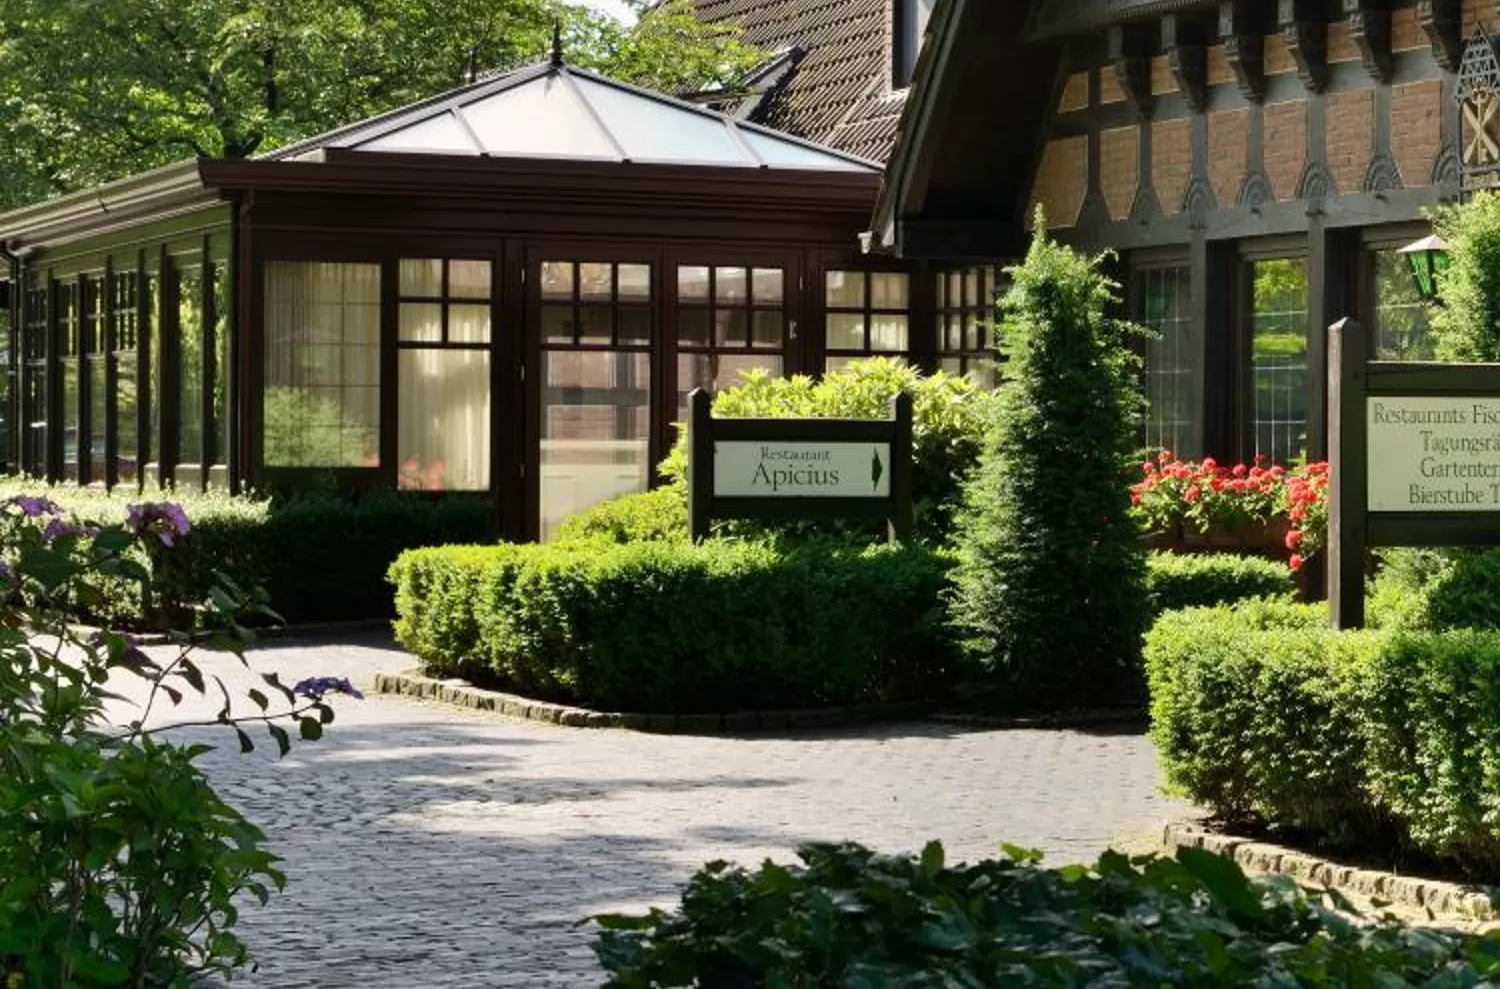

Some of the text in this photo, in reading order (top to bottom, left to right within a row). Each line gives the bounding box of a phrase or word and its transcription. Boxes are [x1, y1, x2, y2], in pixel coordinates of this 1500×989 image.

[1372, 402, 1466, 425] Restaurants
[760, 446, 831, 461] Restaurant
[752, 462, 840, 491] Apicius
[1409, 483, 1484, 505] Bierstube
